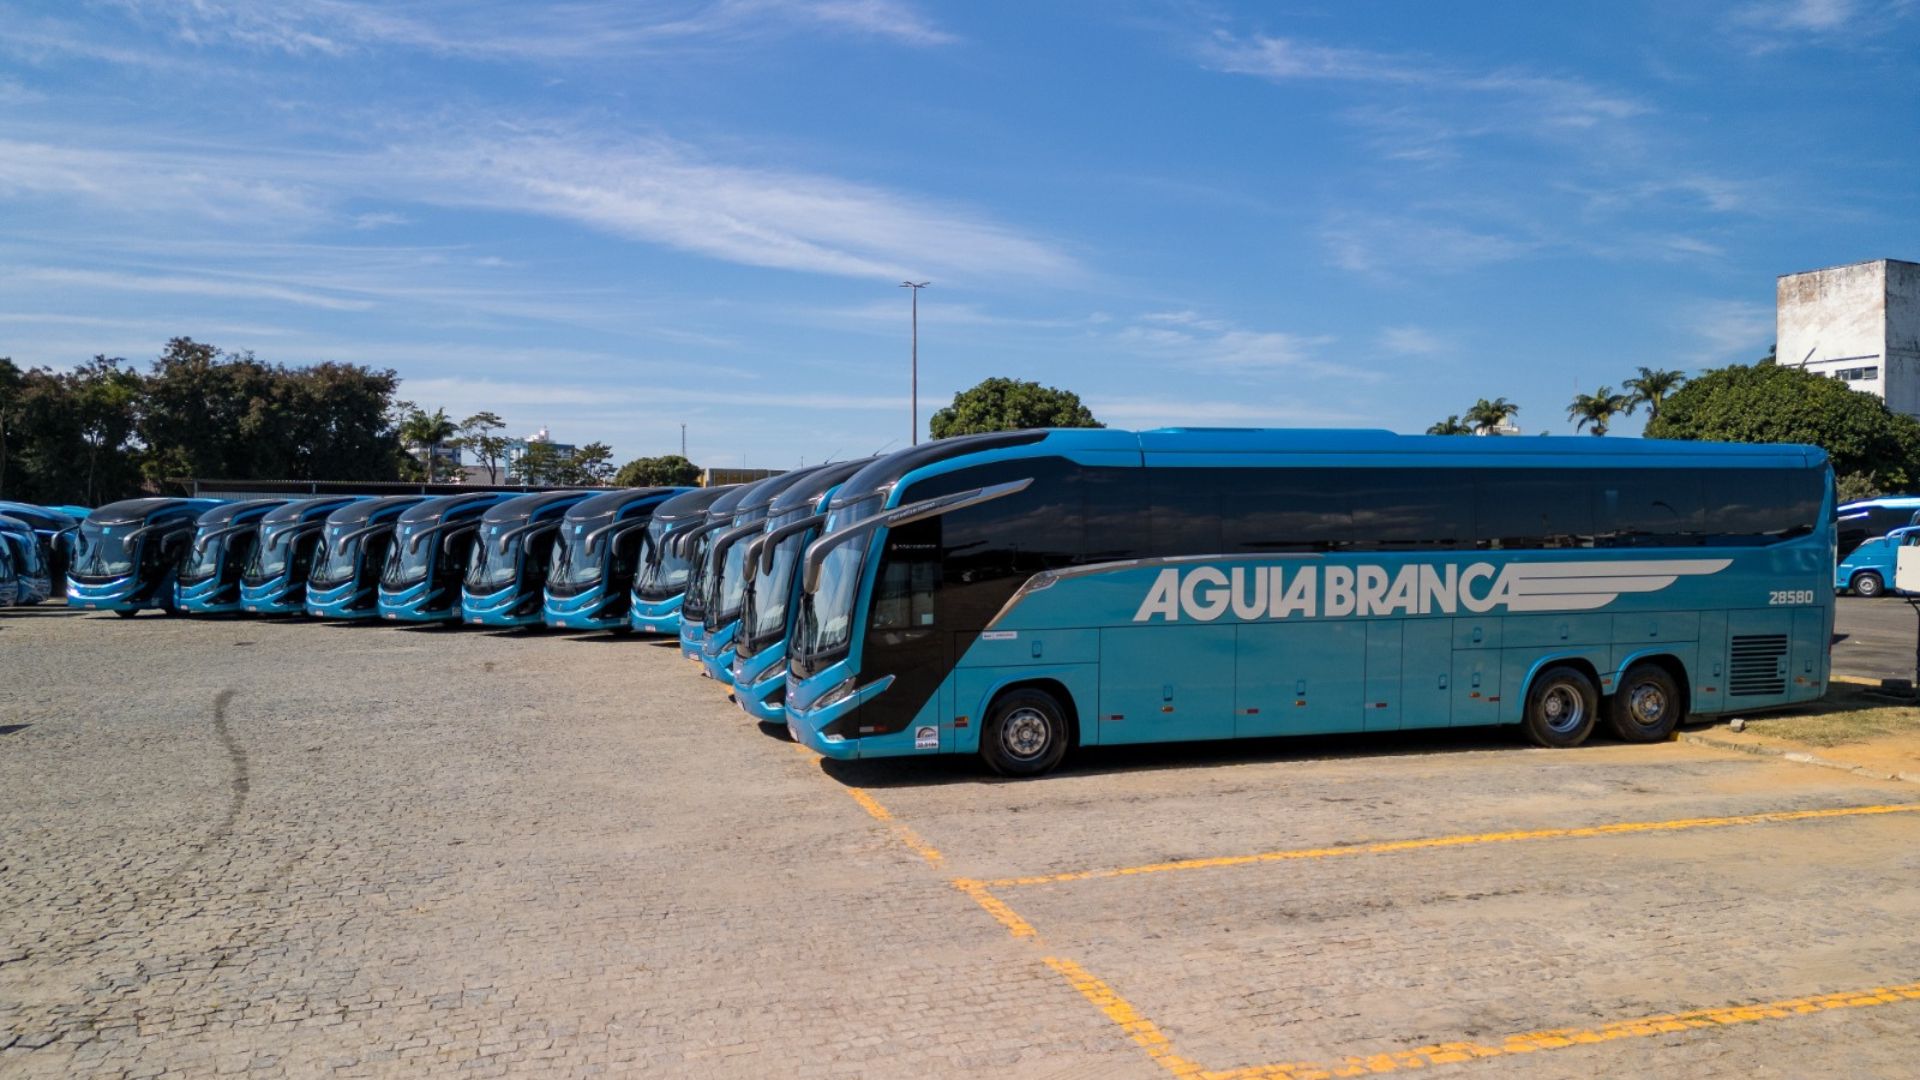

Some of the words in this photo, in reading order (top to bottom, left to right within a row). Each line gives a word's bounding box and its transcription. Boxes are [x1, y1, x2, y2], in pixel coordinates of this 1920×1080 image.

[1133, 566, 1317, 621] AGUIA
[1324, 562, 1520, 617] BRANCA
[1768, 590, 1814, 605] 28580
